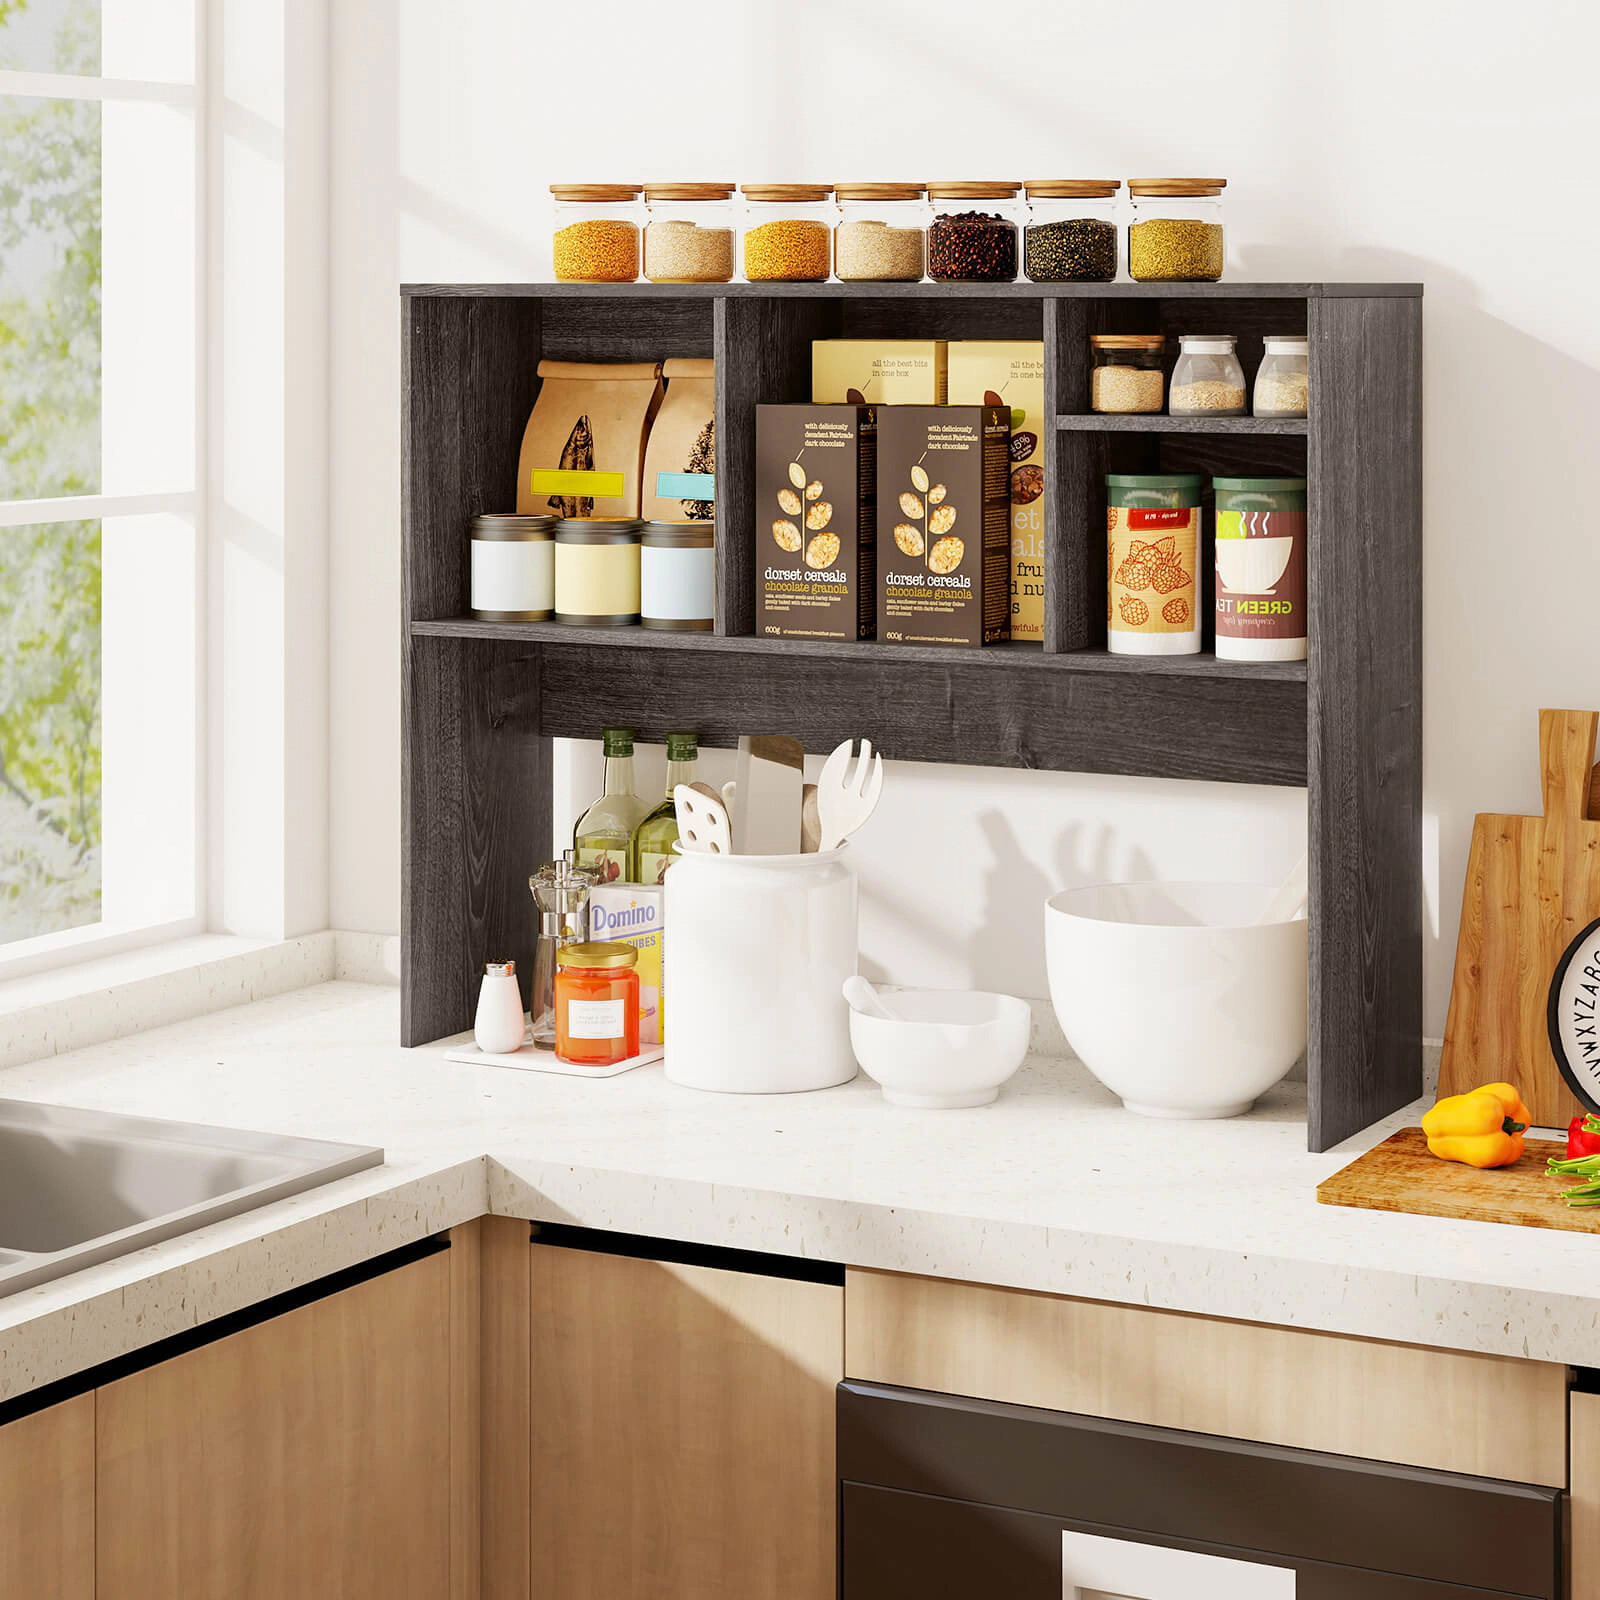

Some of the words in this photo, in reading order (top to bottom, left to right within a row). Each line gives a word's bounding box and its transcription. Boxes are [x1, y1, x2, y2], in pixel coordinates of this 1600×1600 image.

[883, 360, 896, 368] the
[897, 360, 913, 368] best
[914, 360, 928, 368] bits
[819, 423, 848, 431] deliciously
[928, 425, 941, 433] with
[942, 425, 973, 434] deliciously
[928, 442, 941, 450] dark
[942, 442, 970, 450] chocolate
[764, 567, 802, 581] dorset
[804, 570, 847, 583] cereals
[1017, 562, 1044, 577] fru
[886, 572, 925, 586] dorset
[927, 574, 971, 588] cereals
[764, 581, 810, 592] chocolate
[811, 584, 849, 595] granola
[886, 587, 932, 598] chocolate
[934, 588, 973, 601] granola
[765, 626, 781, 635] 600g
[886, 632, 903, 641] 600g
[592, 903, 655, 932] Domino
